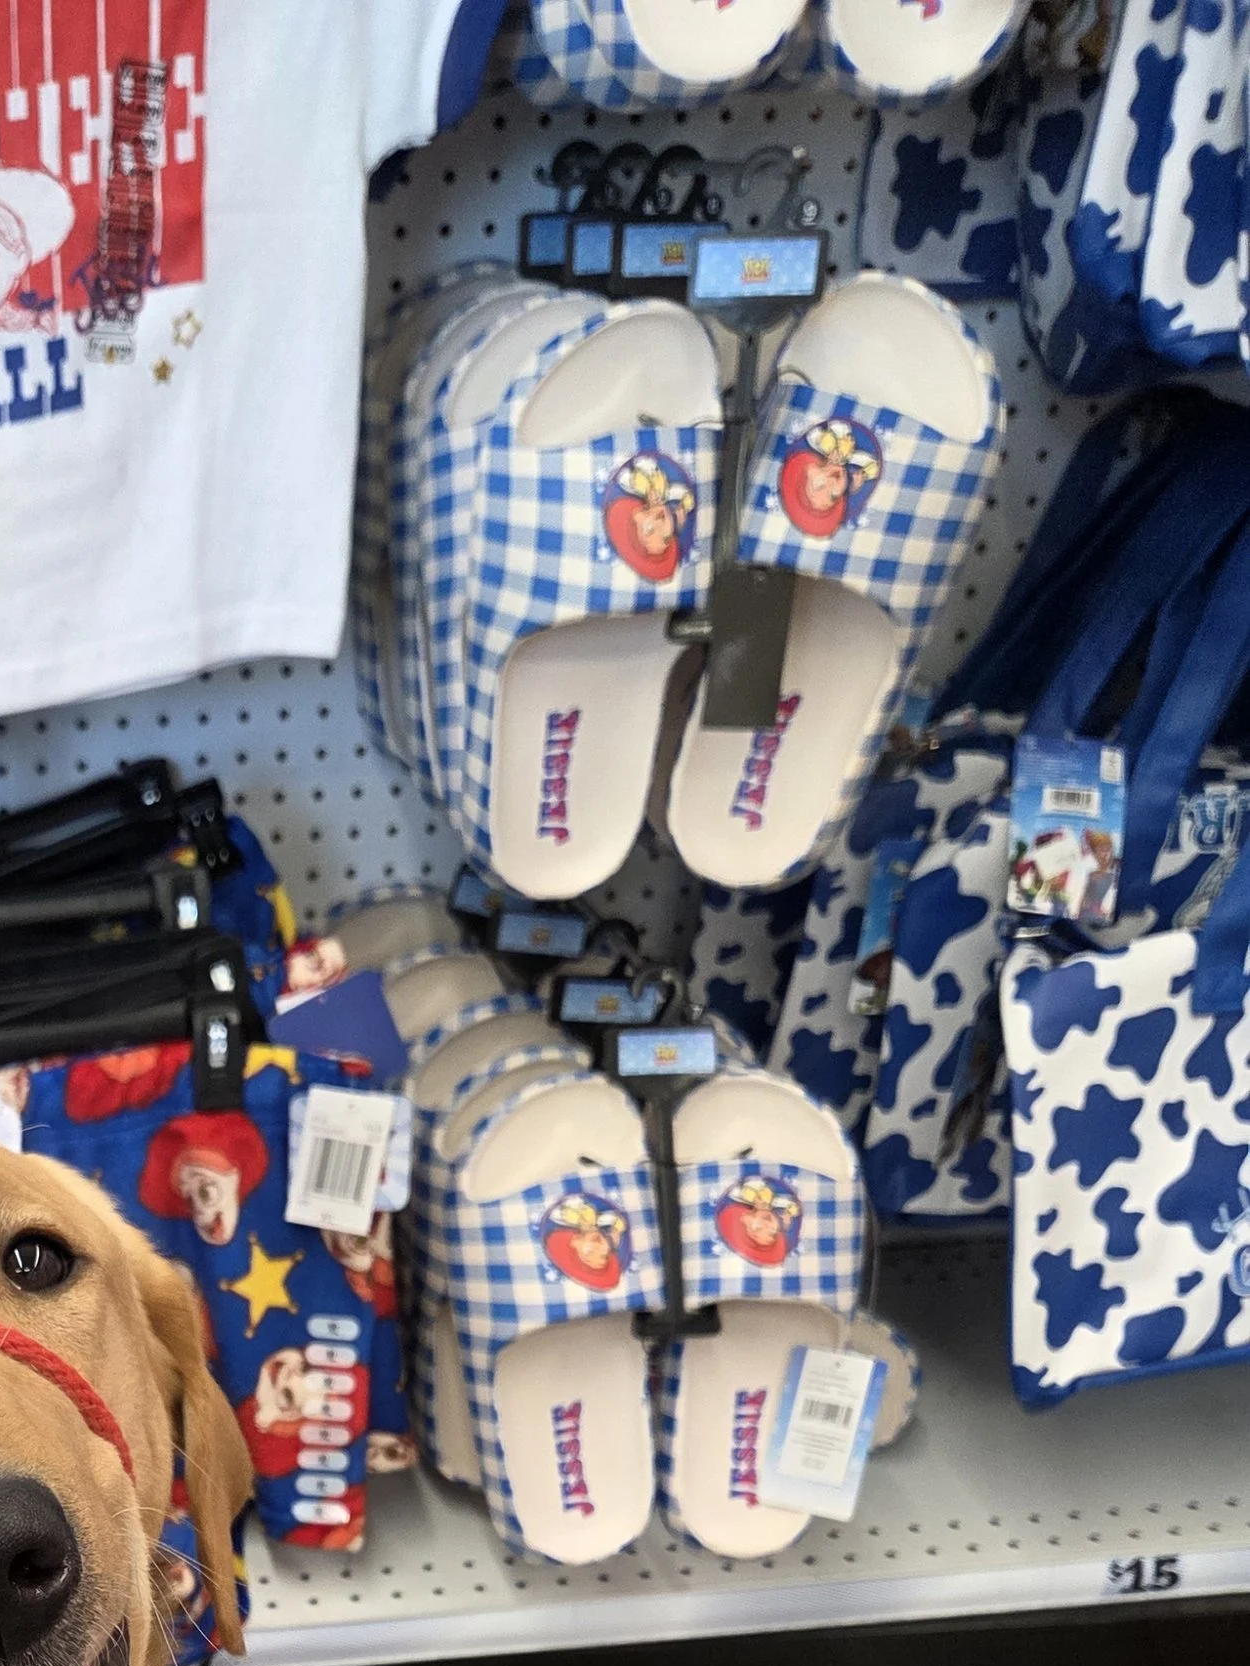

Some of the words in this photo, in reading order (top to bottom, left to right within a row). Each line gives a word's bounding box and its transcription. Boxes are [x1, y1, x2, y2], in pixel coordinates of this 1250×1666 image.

[536, 708, 582, 846] JESSIE
[552, 1400, 595, 1519] JESSIE
[728, 1388, 767, 1509] JESSIE
[1109, 1554, 1180, 1594] $15
